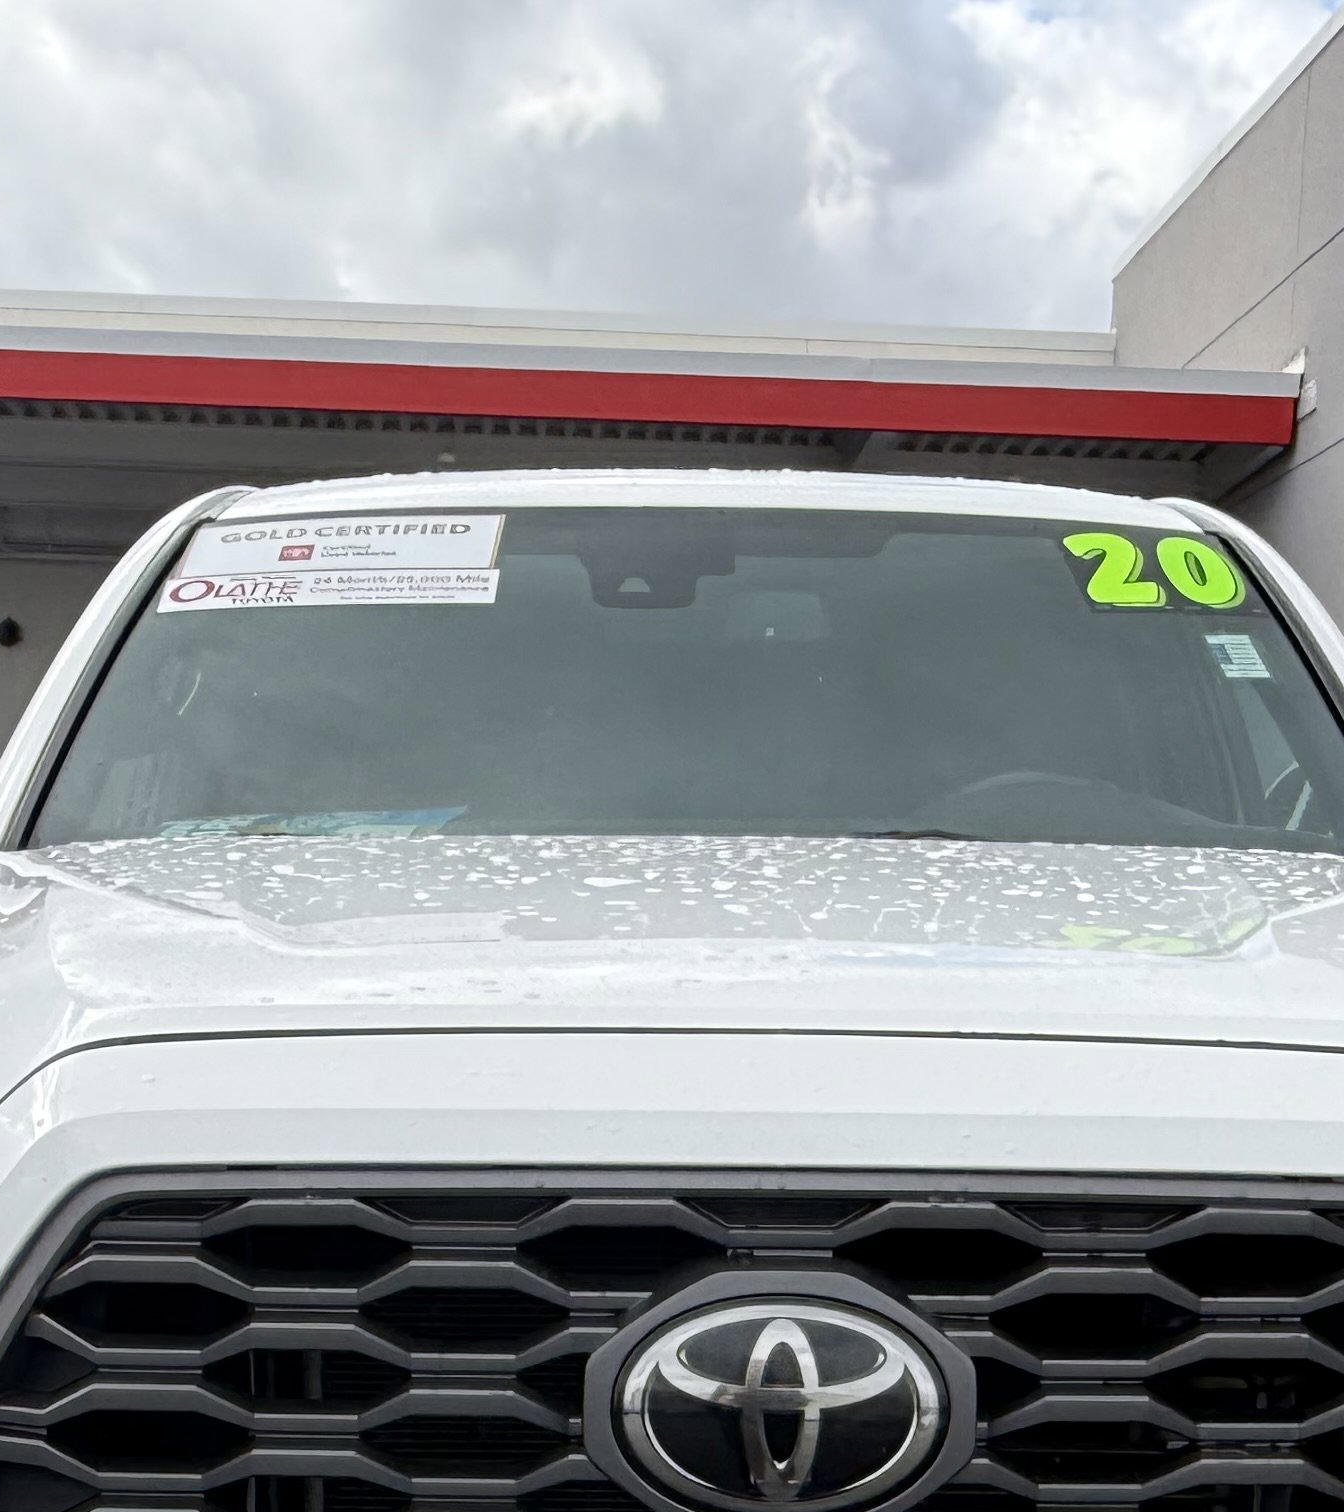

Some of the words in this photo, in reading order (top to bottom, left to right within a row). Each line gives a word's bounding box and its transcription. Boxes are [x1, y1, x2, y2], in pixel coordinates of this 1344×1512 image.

[221, 528, 307, 543] GOLD
[314, 524, 472, 538] CERTIFIED
[1062, 533, 1246, 609] 20
[169, 576, 303, 603] OLATHE
